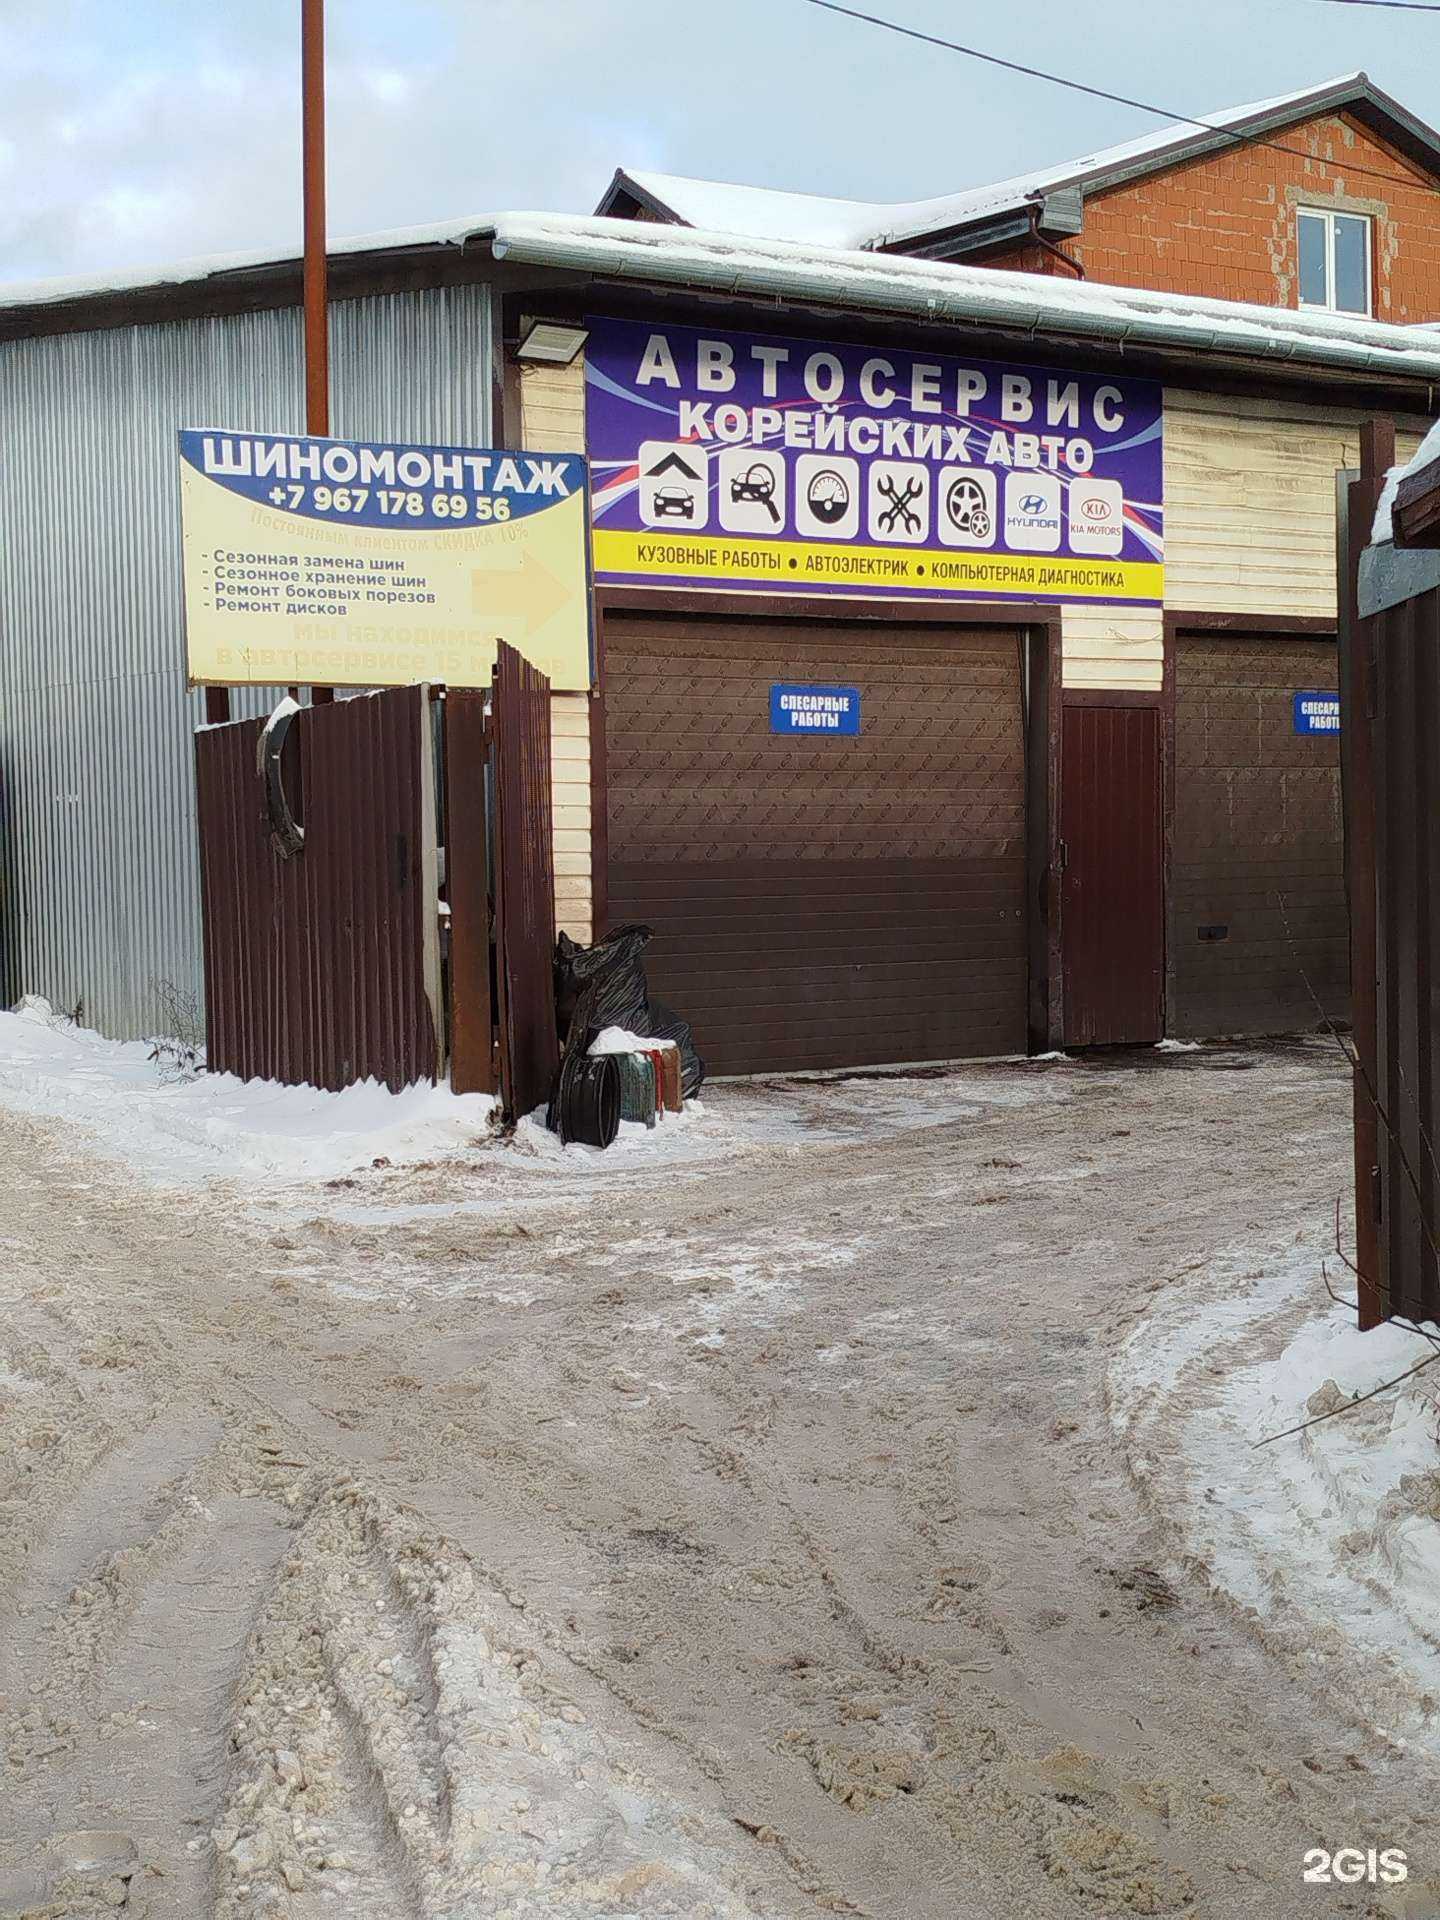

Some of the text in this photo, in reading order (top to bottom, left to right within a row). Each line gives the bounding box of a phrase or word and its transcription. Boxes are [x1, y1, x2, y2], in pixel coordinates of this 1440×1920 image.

[636, 334, 1124, 432] АВТОСЕРВИС
[679, 400, 1094, 473] КОРЕЙСКИХ АВТО
[202, 438, 570, 496] ШИНОМОНТАЖ
[269, 485, 511, 521] +7 967 178 69 56
[1086, 503, 1106, 515] KIA
[1007, 517, 1059, 529] HYUNDAI
[1070, 523, 1121, 536] KIA MOTORS
[213, 549, 405, 571] Сезонная замена шин
[637, 545, 1124, 587] КУЗОВНЫЕ РАБОТЫ АВТОЭЛЕКТРИК КОМПЬЮТЕРНАЯ ДИАГНОСТИКА
[214, 565, 427, 588] Сезонное хранение шин
[215, 582, 436, 604] Ремонт боковых порезов
[216, 598, 347, 616] Ремонт дисков
[780, 694, 849, 712] СЛЕСАРНЫЕ
[1301, 702, 1340, 715] СЛЕСАРН
[791, 711, 839, 727] РАБОТЫ
